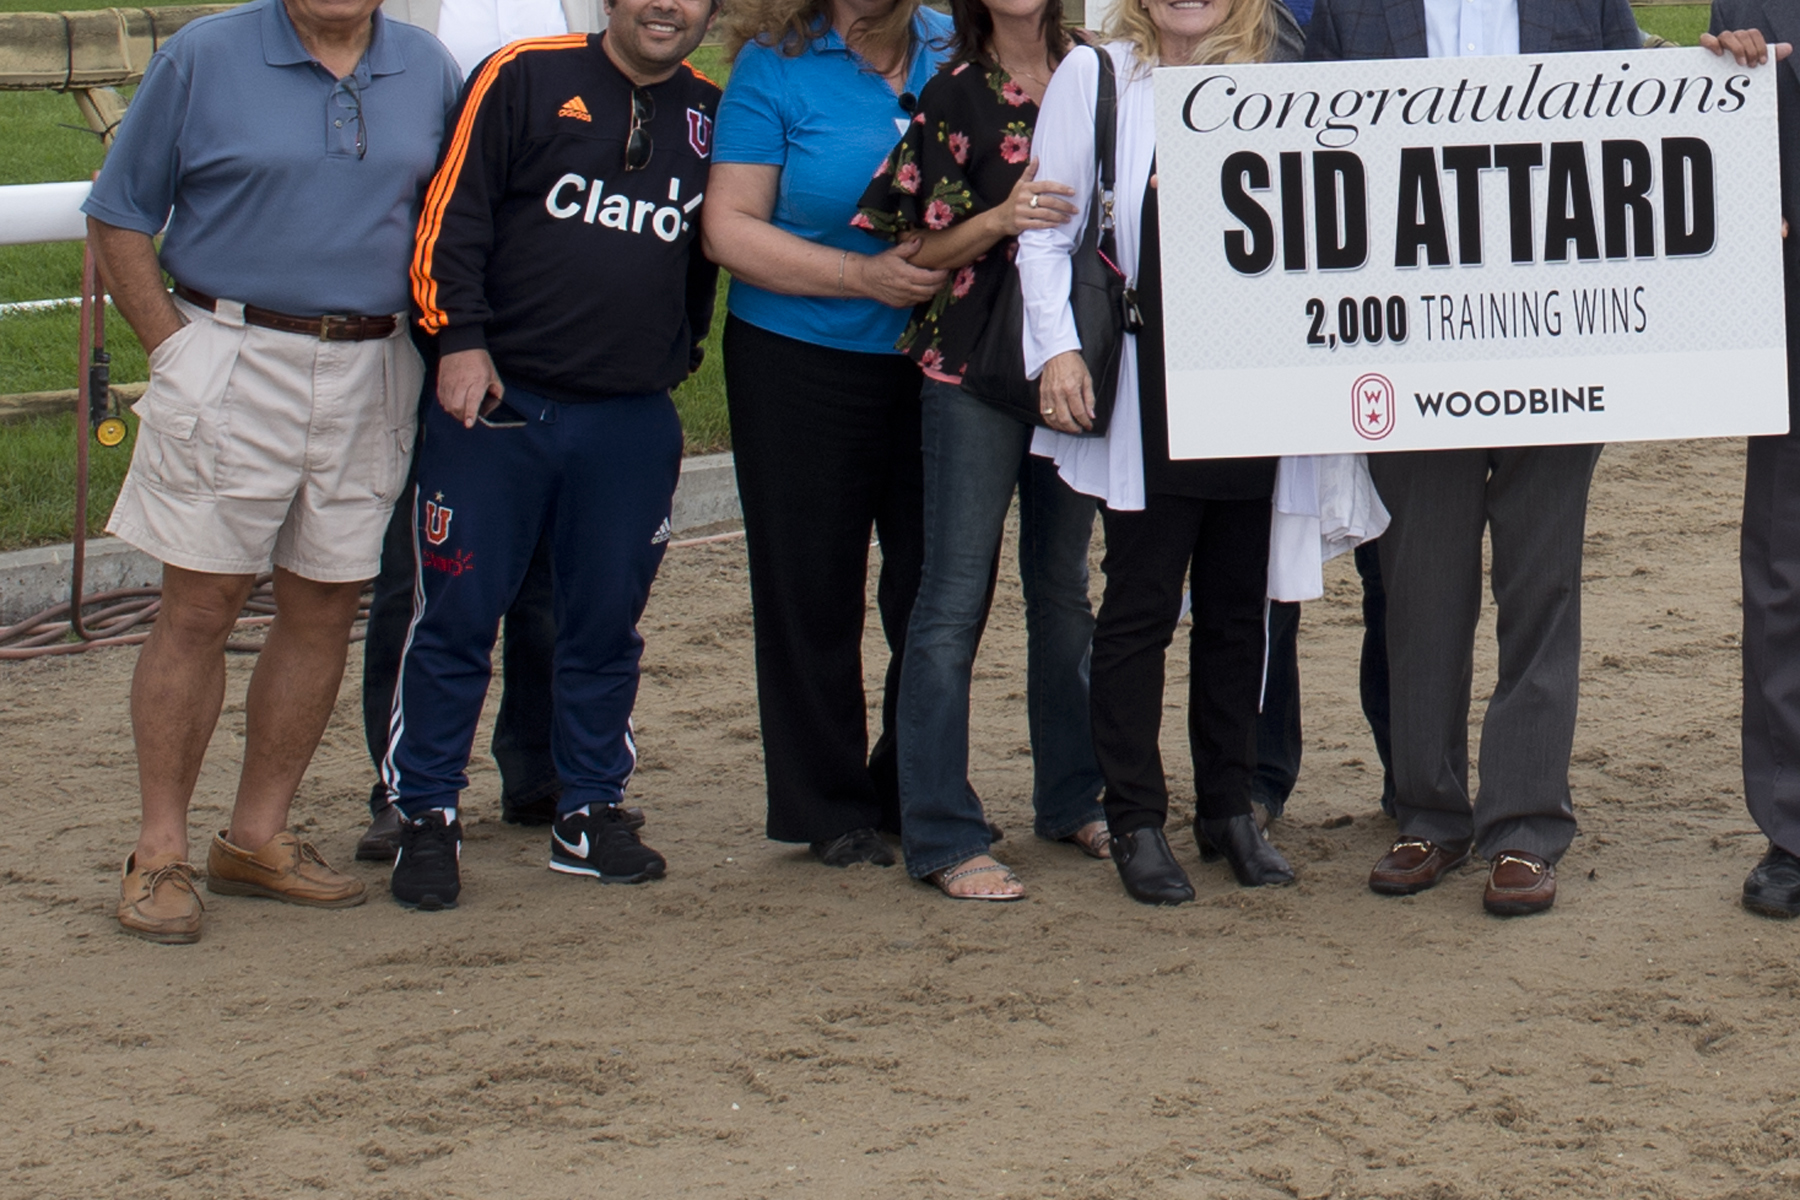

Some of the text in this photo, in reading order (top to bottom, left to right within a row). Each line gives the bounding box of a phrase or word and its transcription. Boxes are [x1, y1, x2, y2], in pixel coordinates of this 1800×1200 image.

[686, 107, 713, 160] U
[1180, 62, 1752, 149] Congratulations
[545, 172, 683, 243] Claro
[1219, 136, 1718, 278] SID ATTARD
[1304, 285, 1648, 351] 2,000 TRAINING WINS
[1413, 385, 1606, 418] WOODBINE
[425, 500, 454, 546] U
